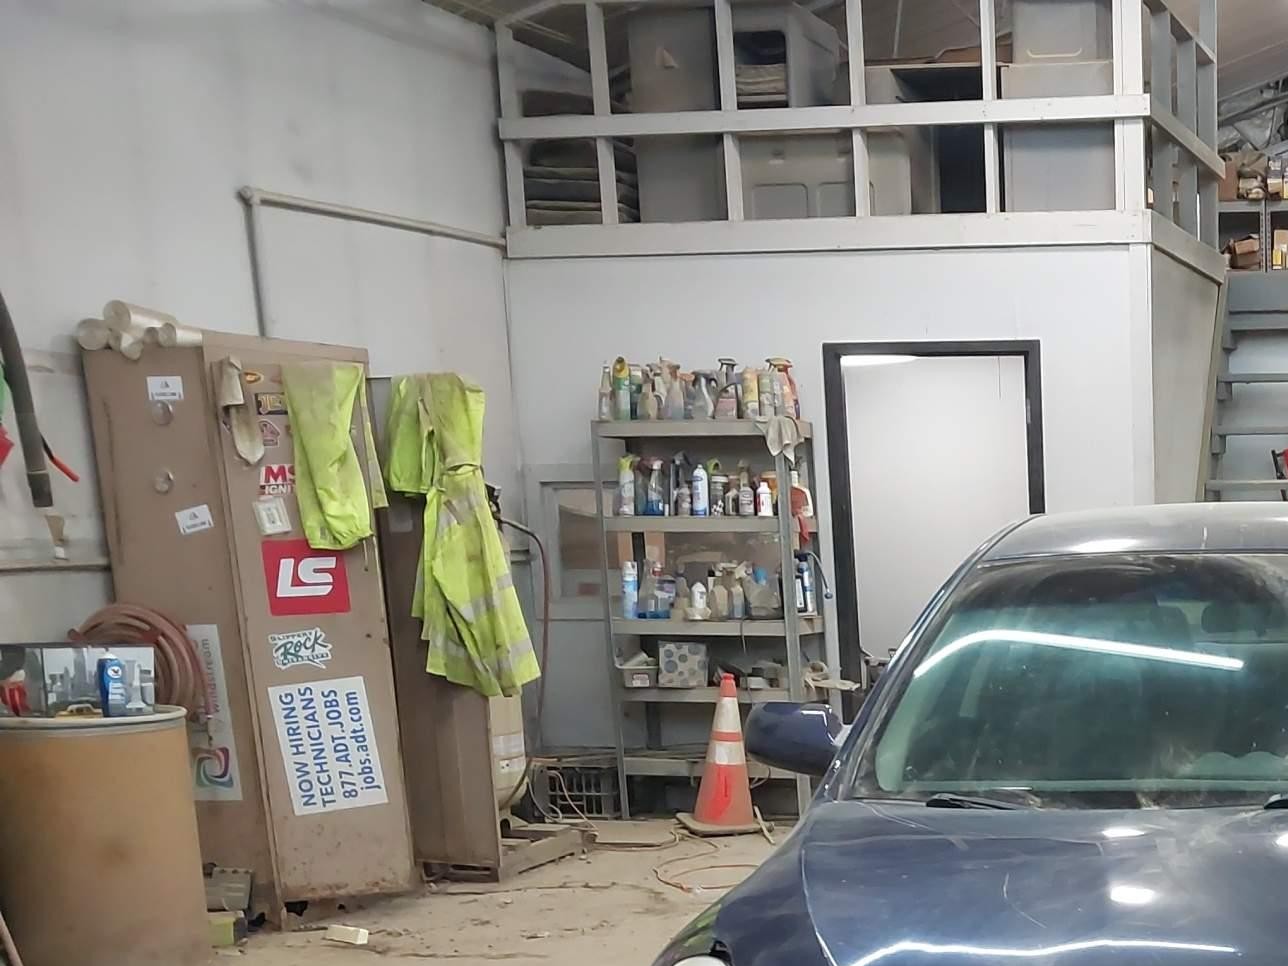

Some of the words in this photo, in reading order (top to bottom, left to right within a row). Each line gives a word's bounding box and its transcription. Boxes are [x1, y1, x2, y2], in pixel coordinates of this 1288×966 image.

[279, 692, 306, 756] HIRING
[298, 686, 336, 807] TECHNICIANS
[321, 689, 358, 798] 877.ADT.JOBS
[345, 691, 381, 790] jobs.adt.com
[293, 762, 317, 807] NOW
